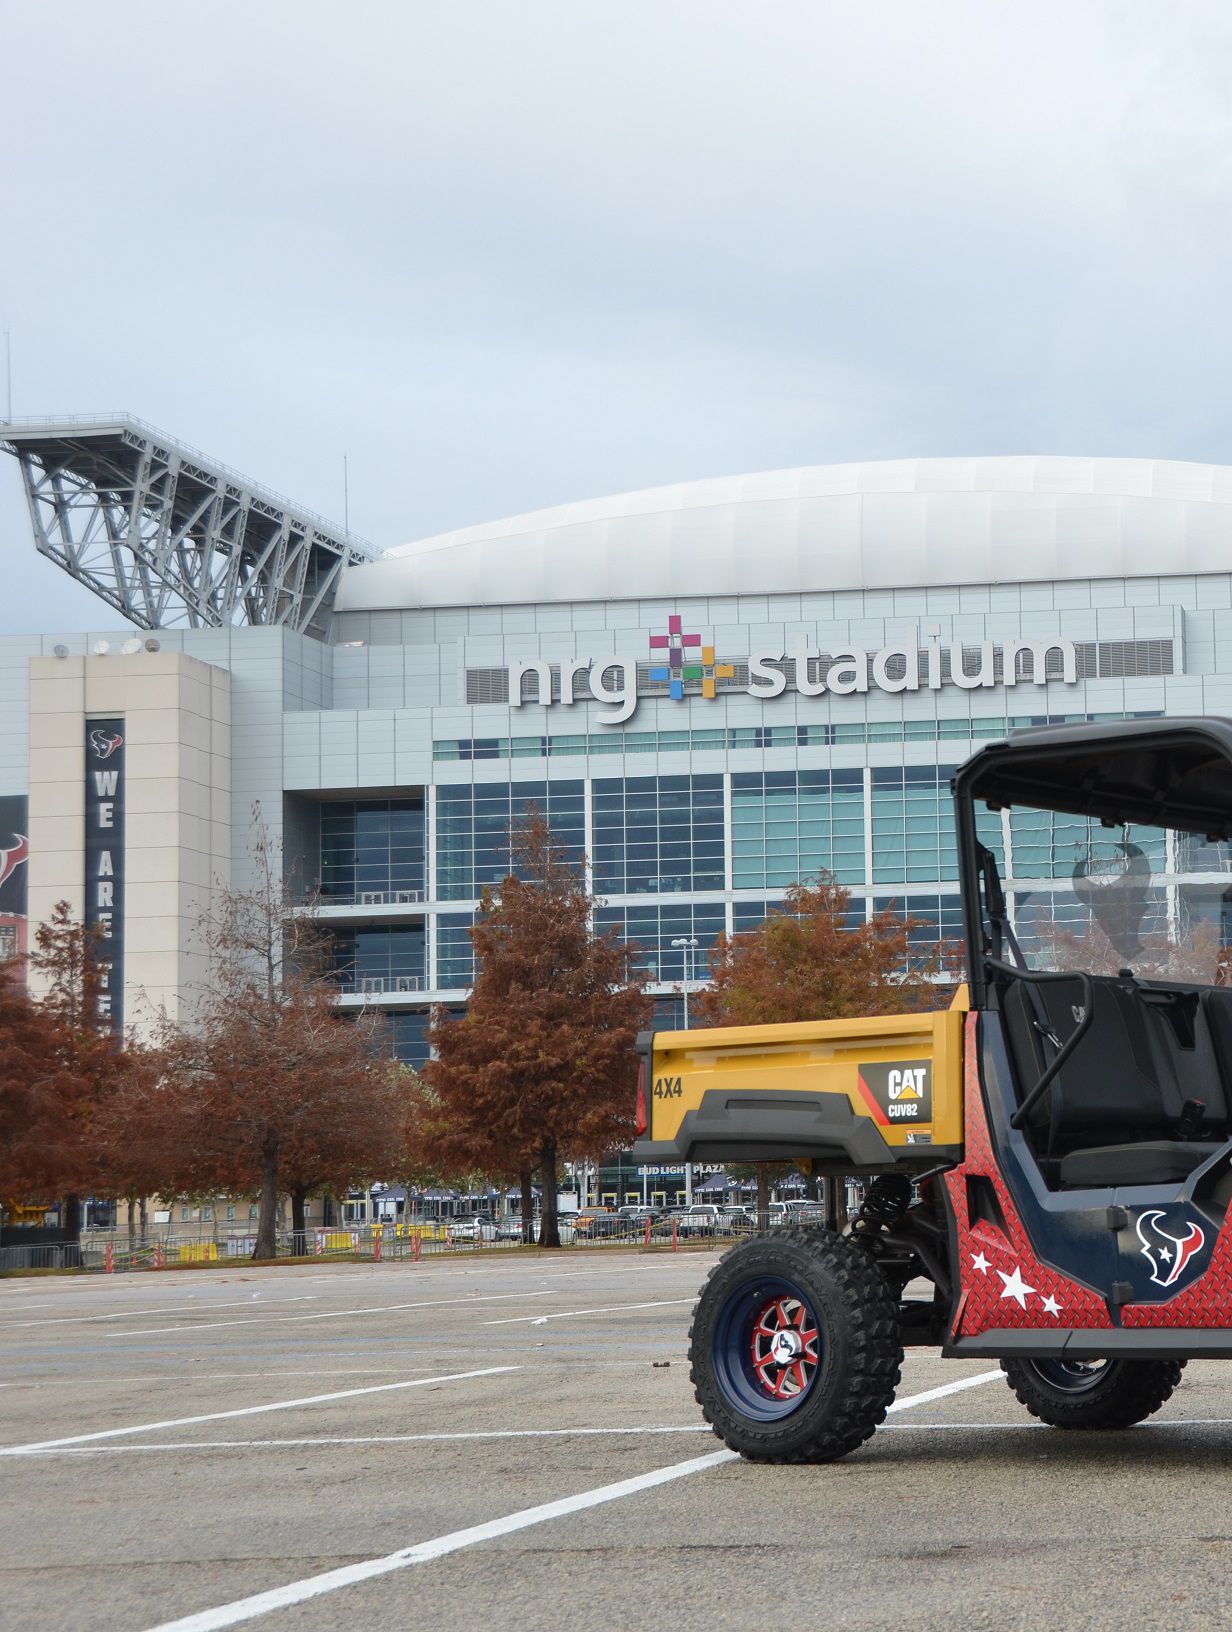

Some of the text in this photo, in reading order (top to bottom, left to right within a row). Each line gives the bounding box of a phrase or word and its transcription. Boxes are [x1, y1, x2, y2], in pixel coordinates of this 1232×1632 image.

[508, 623, 1077, 725] nrg stadium
[94, 771, 119, 828] WE
[1071, 1005, 1086, 1024] CA
[654, 1076, 683, 1099] 4X4
[888, 1068, 926, 1100] CAT
[888, 1103, 918, 1117] CUV82
[637, 1166, 660, 1175] BUD
[693, 1164, 725, 1174] PLAZA
